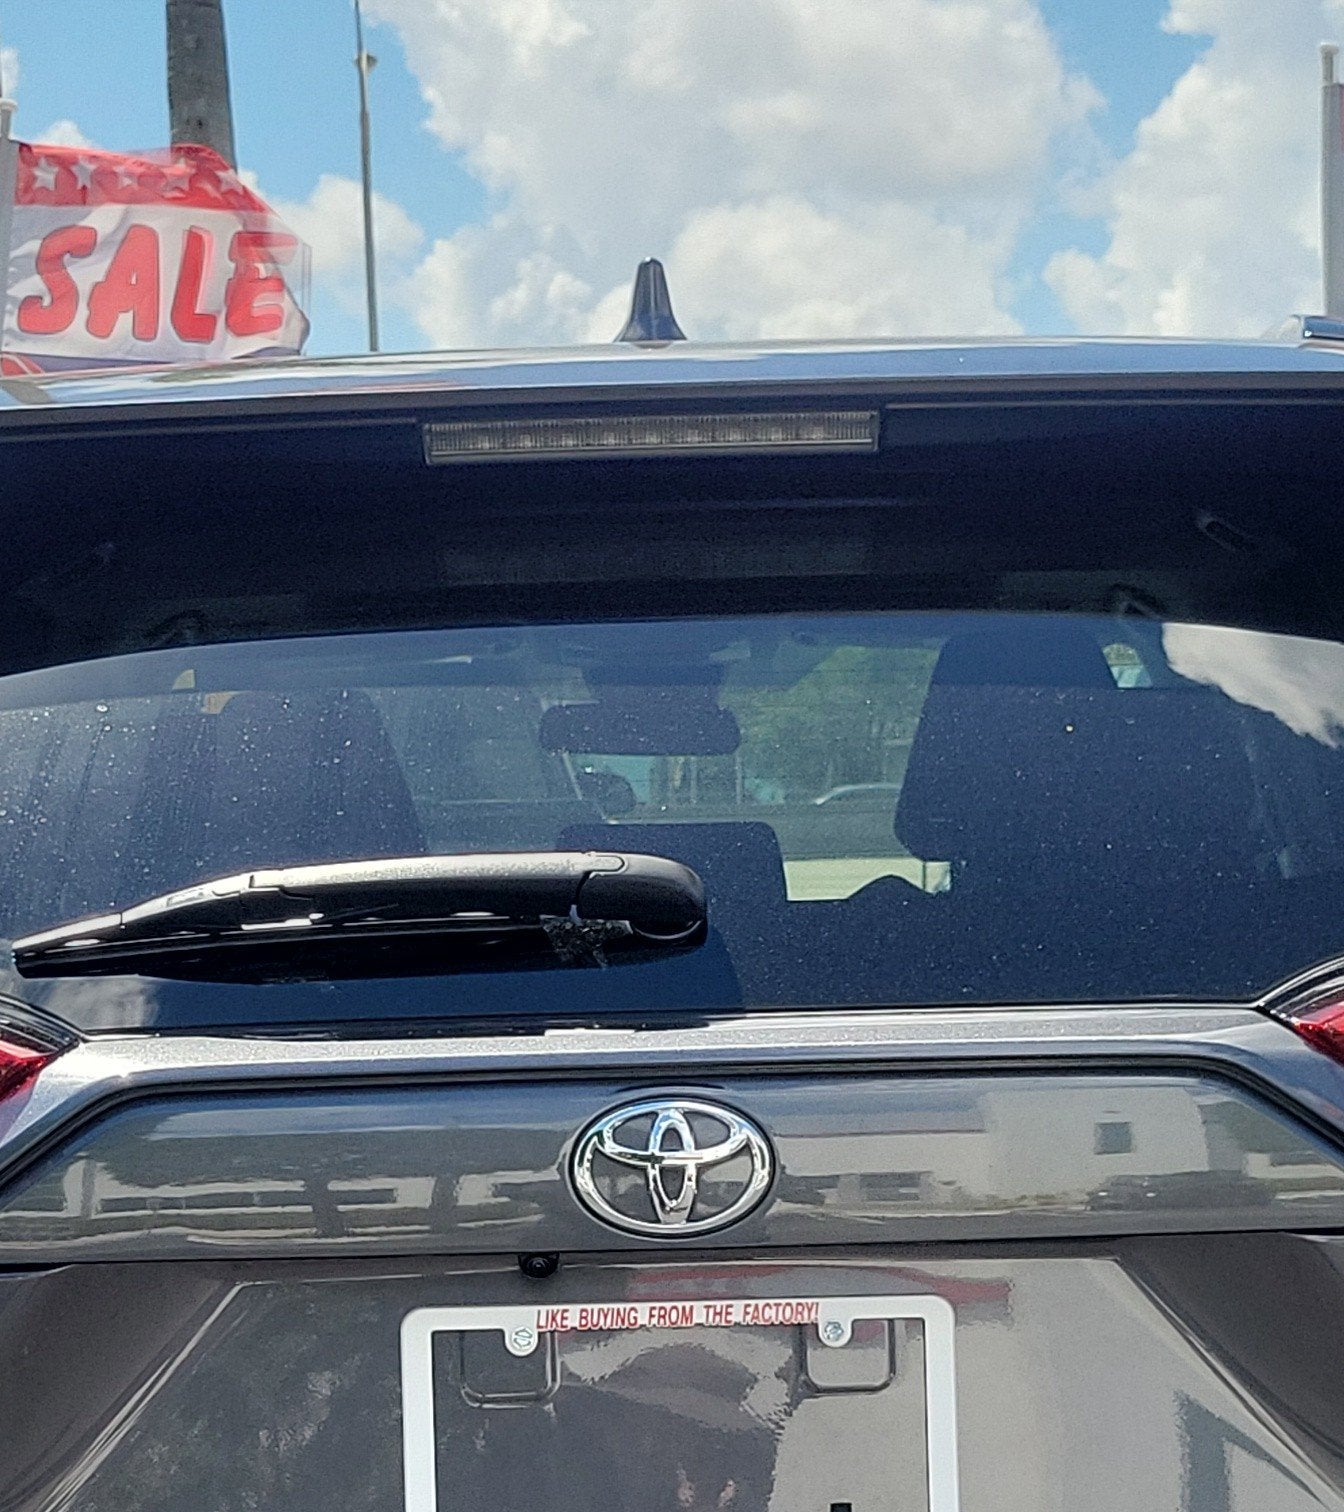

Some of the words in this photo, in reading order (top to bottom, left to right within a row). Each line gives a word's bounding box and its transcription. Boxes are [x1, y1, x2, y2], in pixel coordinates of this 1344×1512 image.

[17, 223, 299, 343] SALE
[536, 1308, 570, 1330] LIKE
[578, 1306, 639, 1329] BUYING
[647, 1304, 695, 1328] FROM
[703, 1303, 734, 1326] THE
[742, 1301, 820, 1325] FACTORY!
